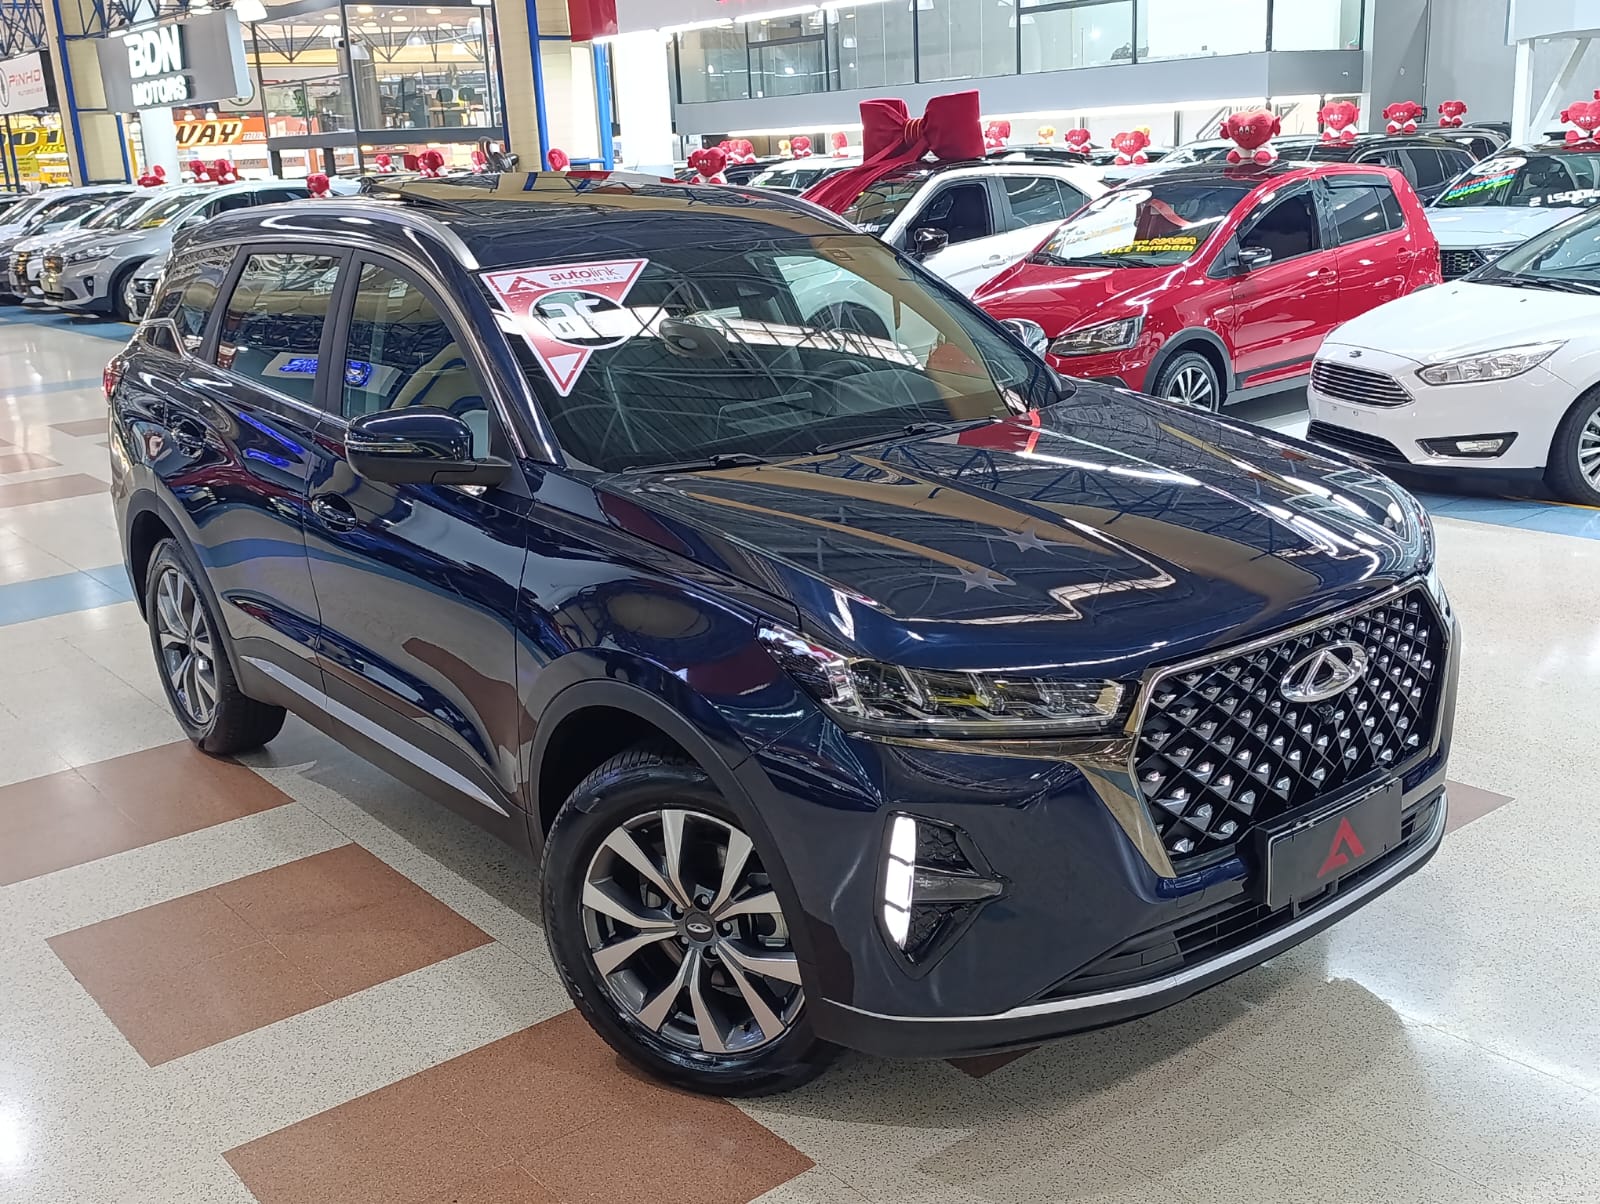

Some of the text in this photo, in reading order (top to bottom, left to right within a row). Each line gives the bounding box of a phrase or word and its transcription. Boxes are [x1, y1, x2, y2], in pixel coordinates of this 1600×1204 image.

[123, 24, 182, 78] BDN
[132, 75, 187, 106] MOTORS
[549, 266, 621, 282] autolink
